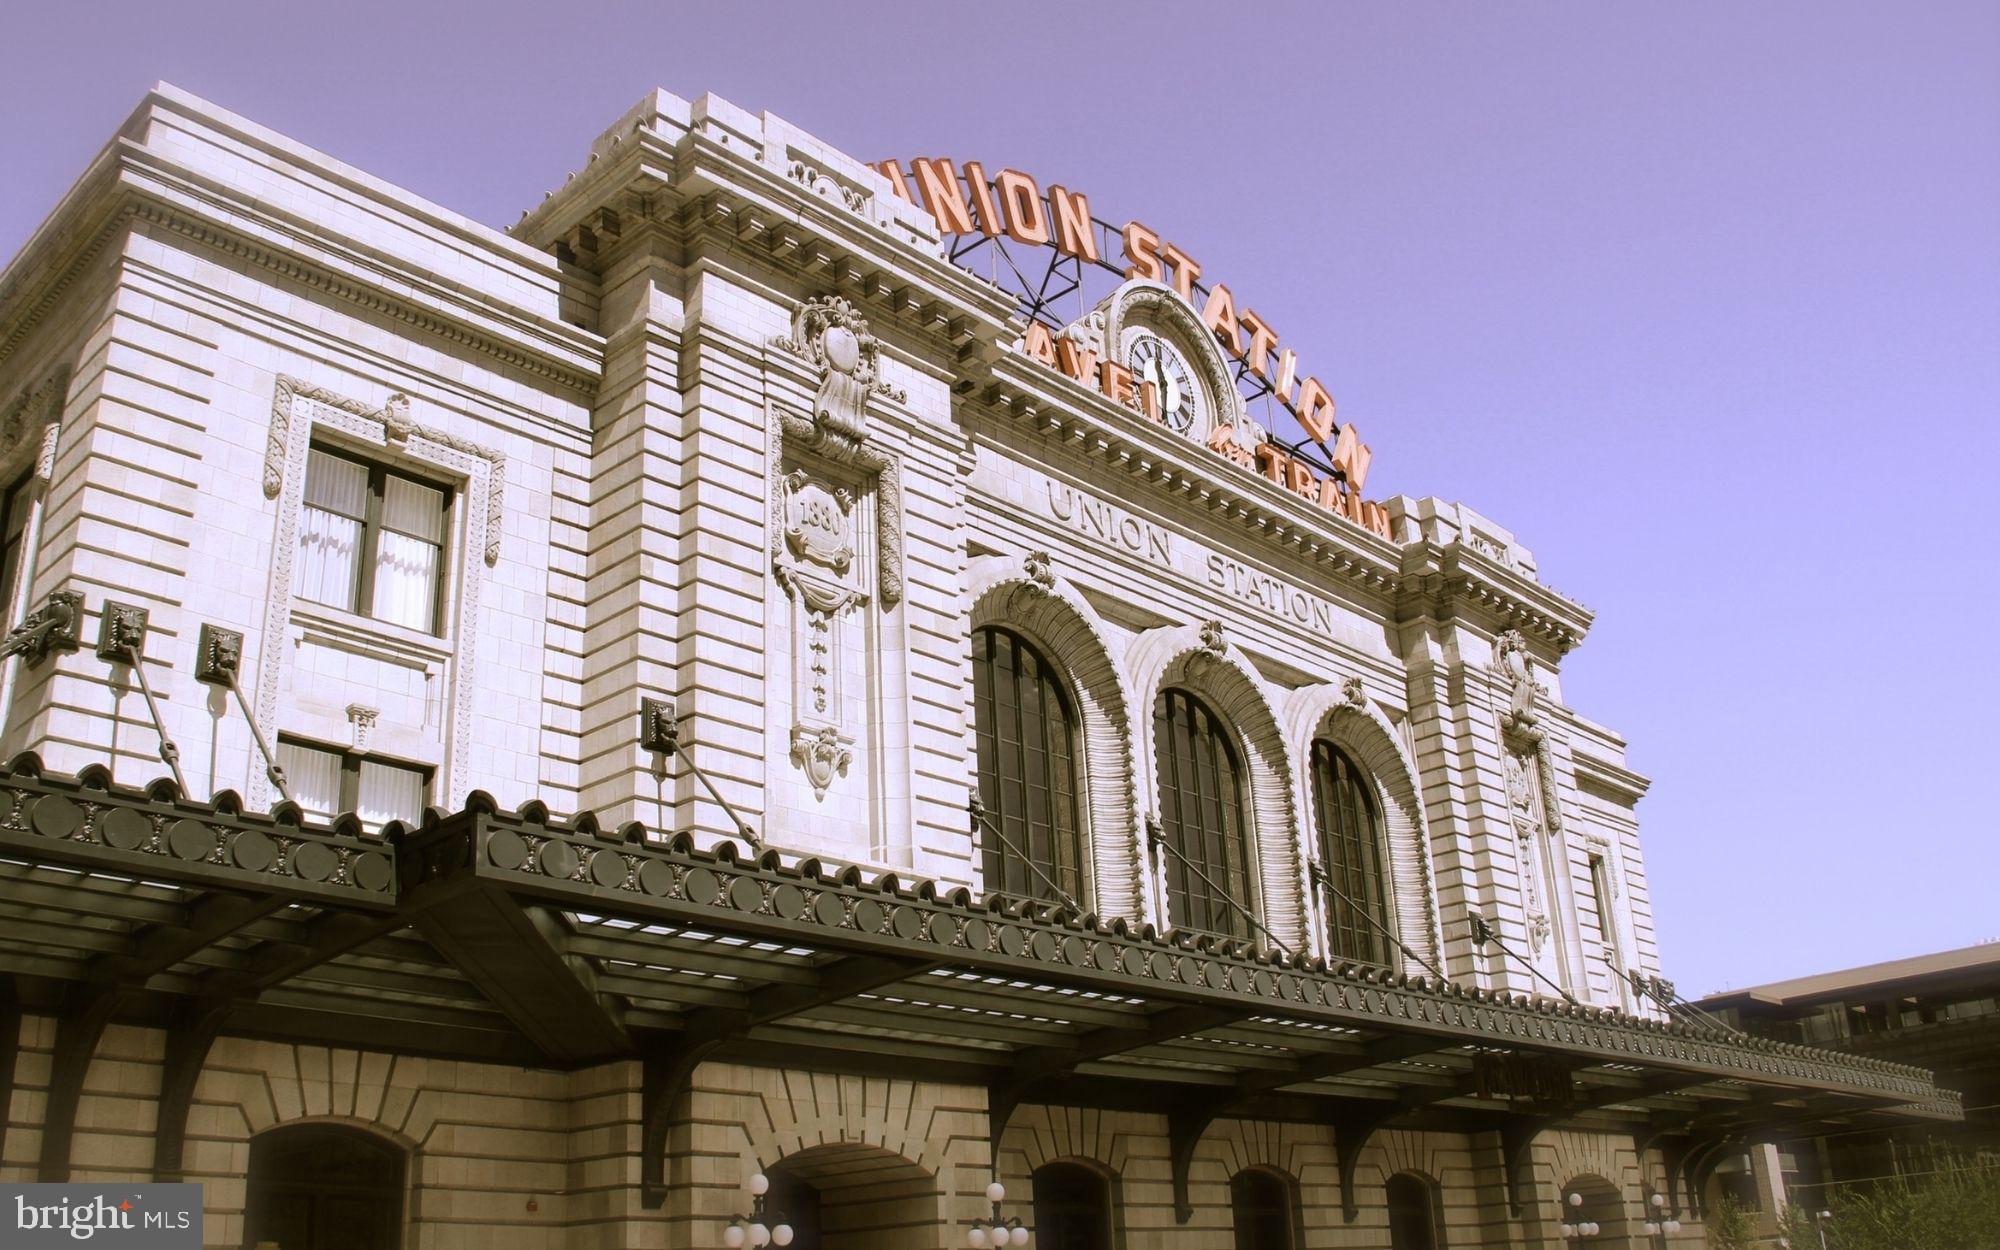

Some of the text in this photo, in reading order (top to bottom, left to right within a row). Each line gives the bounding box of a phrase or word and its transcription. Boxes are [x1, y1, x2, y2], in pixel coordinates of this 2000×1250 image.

[1121, 220, 1373, 492] STATION
[1046, 480, 1332, 634] UNION STATION
[1254, 442, 1394, 541] TRAIN
